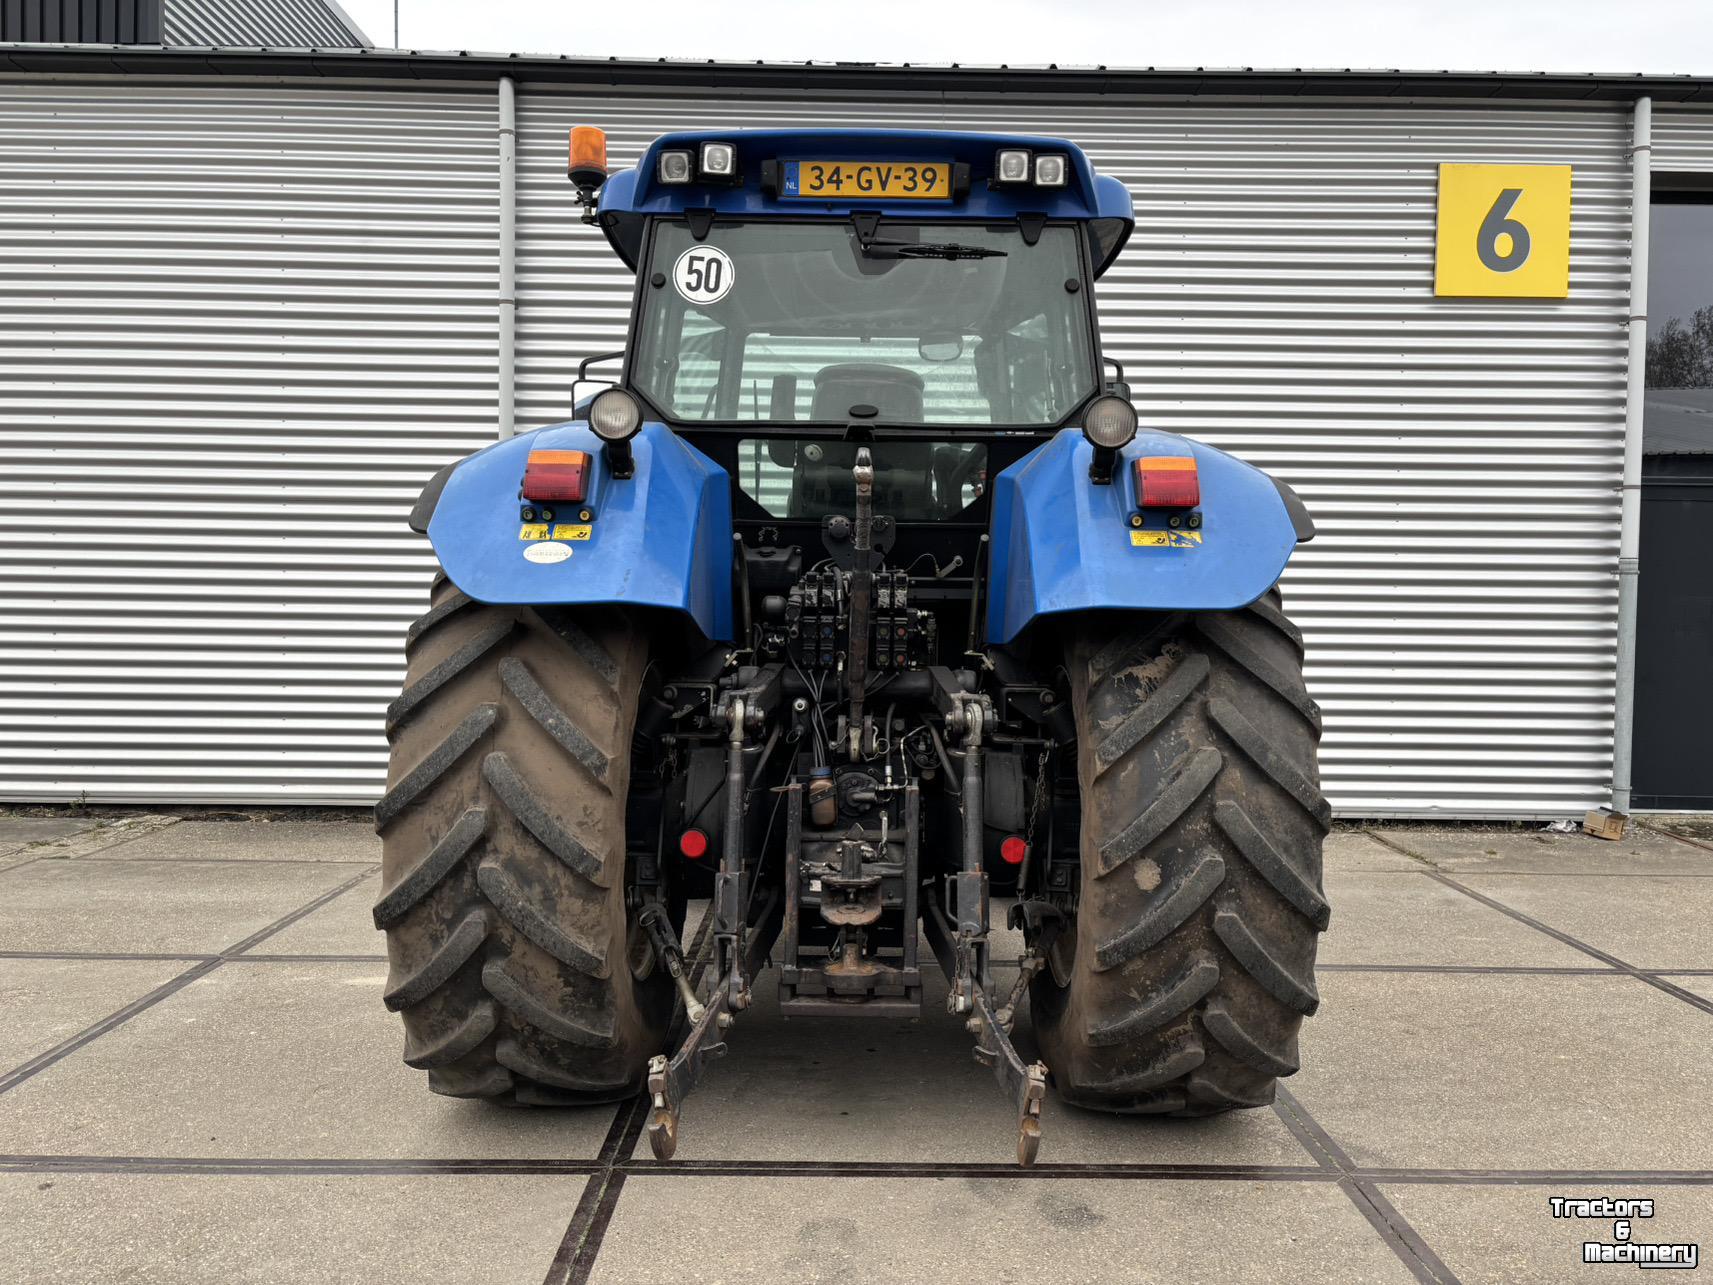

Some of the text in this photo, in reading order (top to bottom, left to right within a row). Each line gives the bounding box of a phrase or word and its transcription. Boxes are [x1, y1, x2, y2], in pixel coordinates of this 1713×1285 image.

[785, 181, 798, 190] NL
[809, 165, 938, 192] 34-GV-39
[1476, 188, 1531, 273] 6
[685, 255, 722, 293] 50
